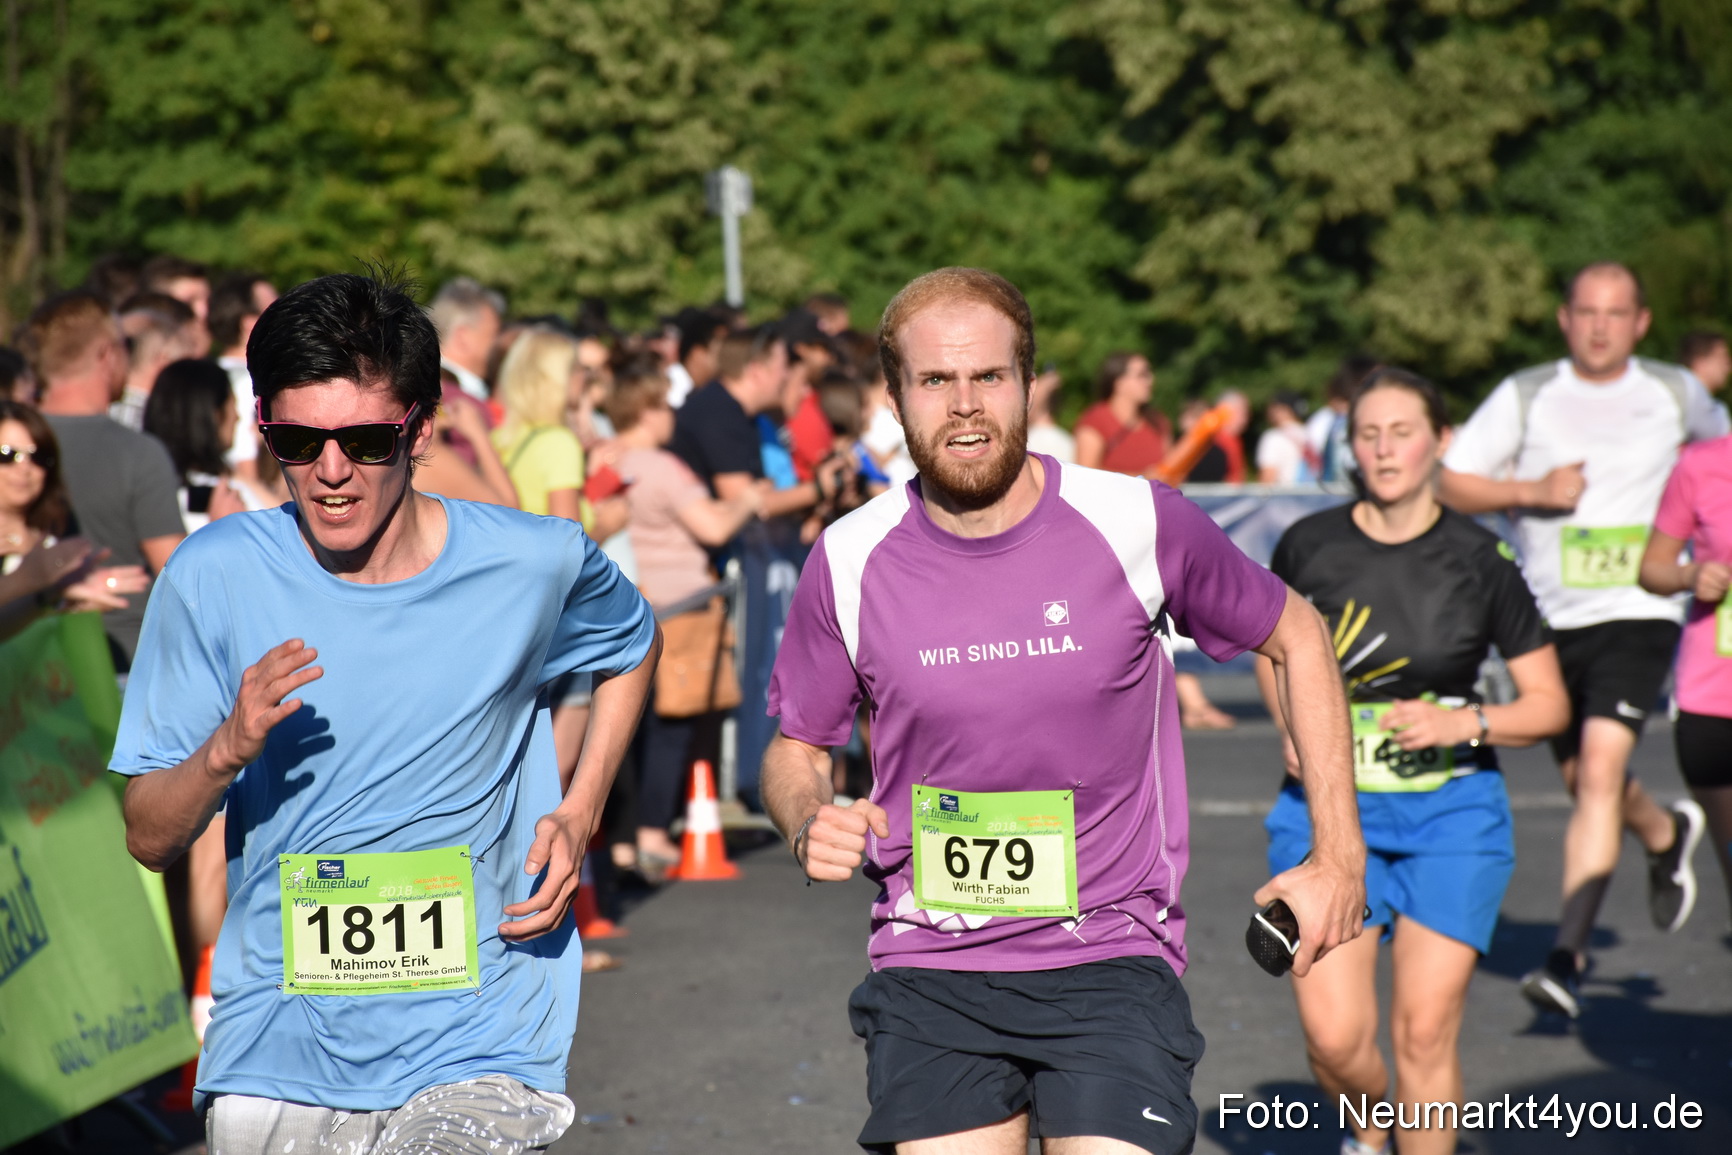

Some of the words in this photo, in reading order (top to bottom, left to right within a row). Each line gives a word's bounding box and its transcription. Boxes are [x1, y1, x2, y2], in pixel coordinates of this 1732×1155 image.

[919, 647, 960, 666] WIR
[967, 641, 1020, 662] SIND
[1026, 635, 1083, 656] LILA.
[931, 808, 979, 823] firmenlauf
[987, 821, 1017, 832] 2018
[944, 836, 1034, 881] 679
[306, 876, 370, 888] firmenlauf
[952, 881, 984, 894] Wirth
[987, 883, 1030, 895] Fabian
[379, 886, 412, 897] 2018
[975, 896, 1005, 905] FUCHS
[307, 901, 443, 955] 1811
[331, 957, 396, 970] Mahimov
[401, 955, 430, 967] Erik
[294, 972, 333, 980] Senioren-
[343, 972, 389, 982] Pflegeheim
[392, 971, 403, 979] St.
[406, 969, 439, 977] Therese
[441, 965, 467, 975] GmbH
